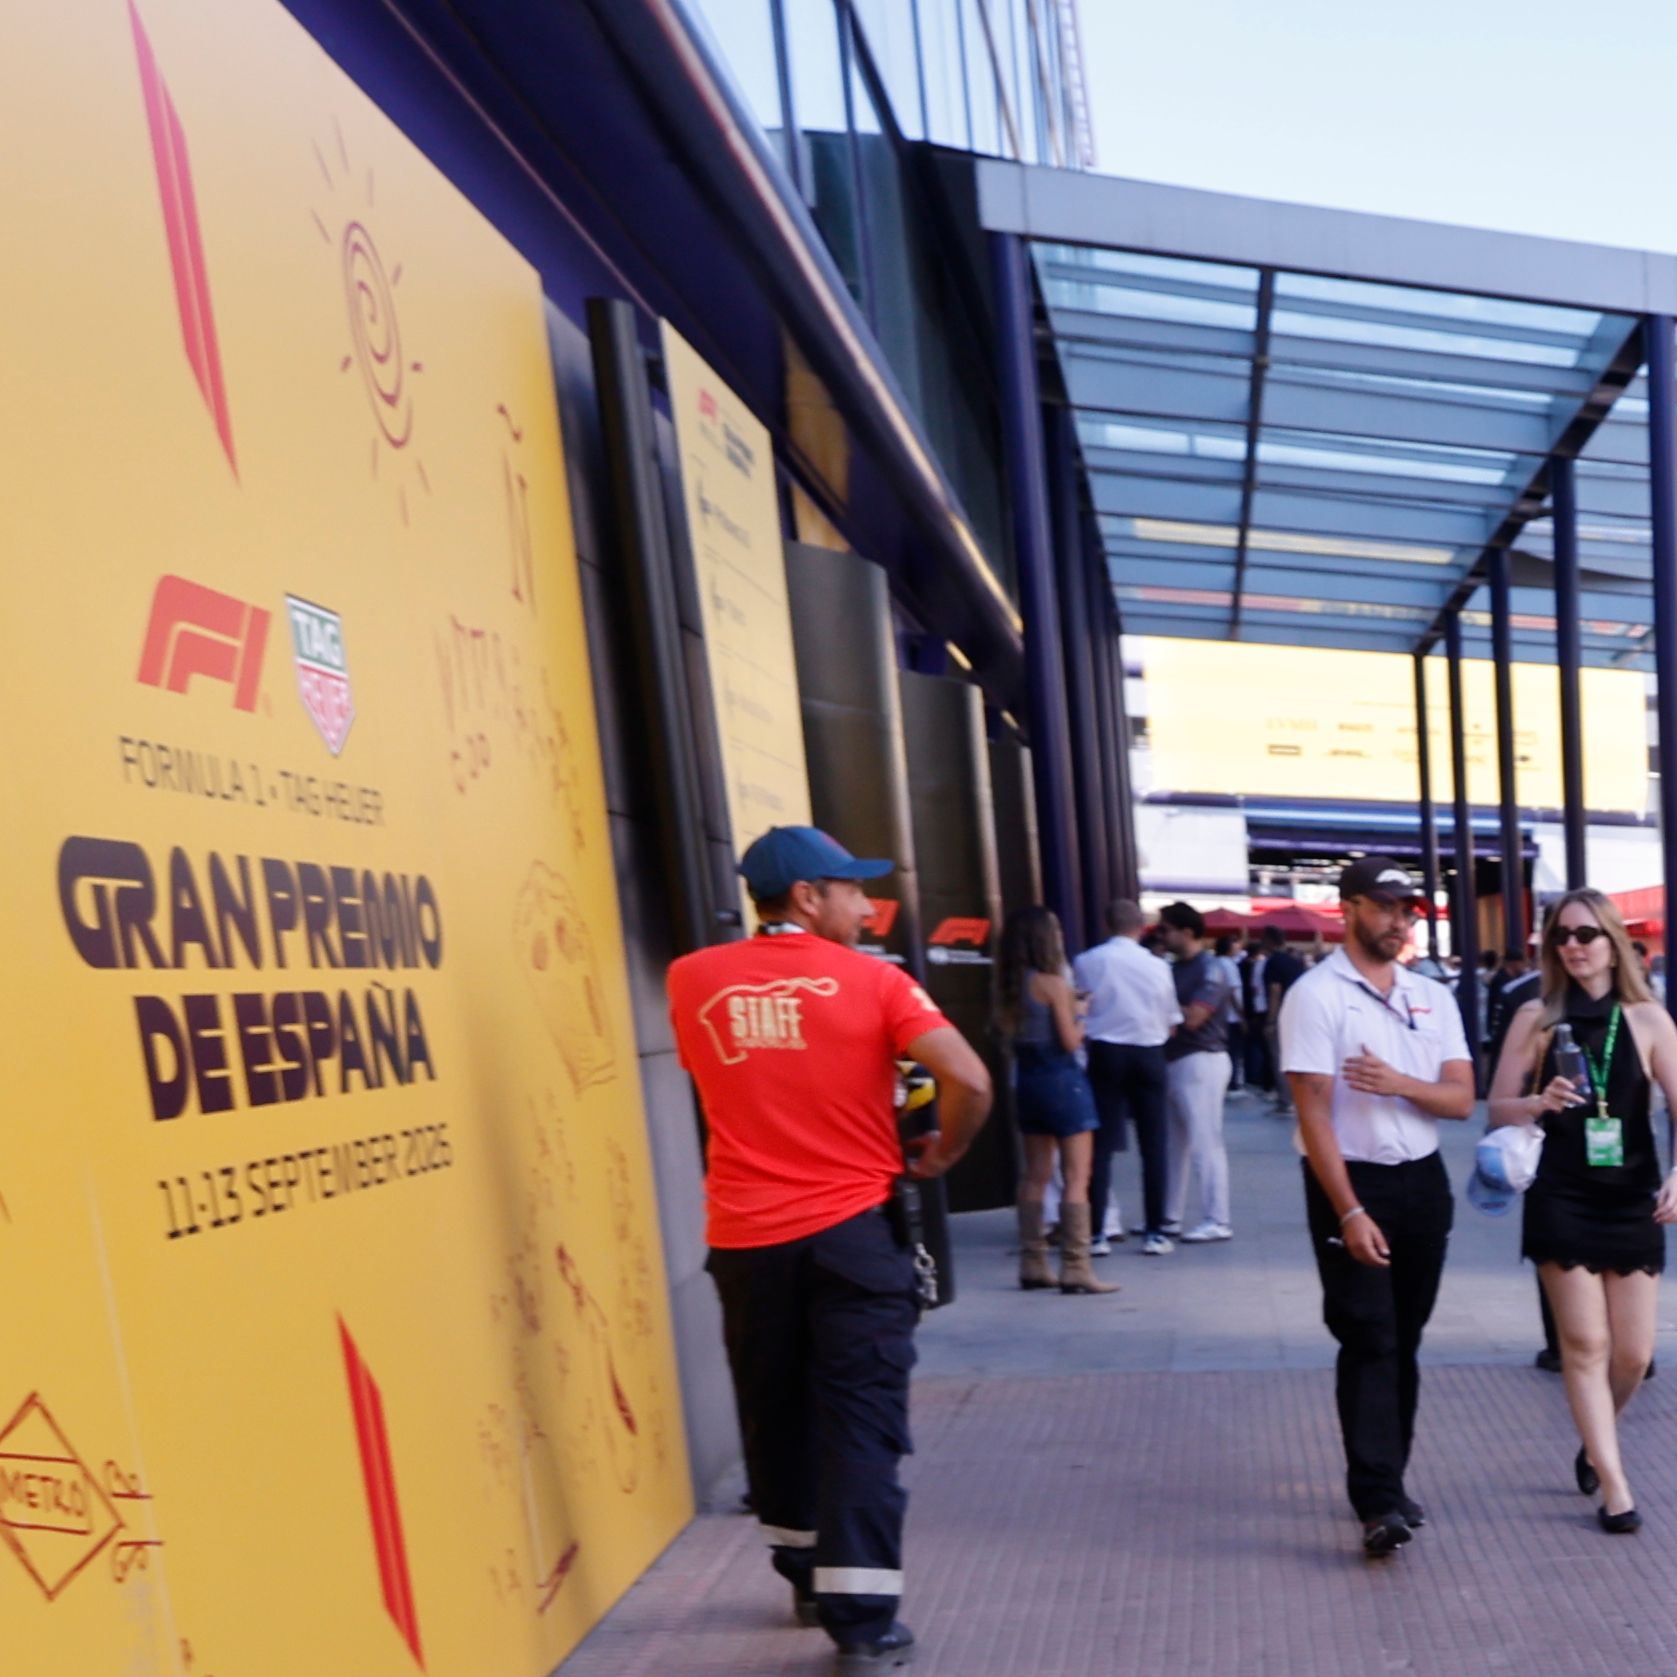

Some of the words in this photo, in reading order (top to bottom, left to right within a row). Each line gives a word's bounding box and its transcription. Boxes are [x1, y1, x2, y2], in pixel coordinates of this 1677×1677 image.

[118, 736, 248, 804] FORMULA
[324, 782, 387, 826] HEUER
[57, 835, 262, 970] GRAN
[259, 856, 443, 971] PREMIO
[133, 994, 237, 1122] DE
[231, 979, 437, 1108] ESPAÑA
[728, 995, 804, 1040] STAFF
[246, 1133, 400, 1217] SEPTEMBER
